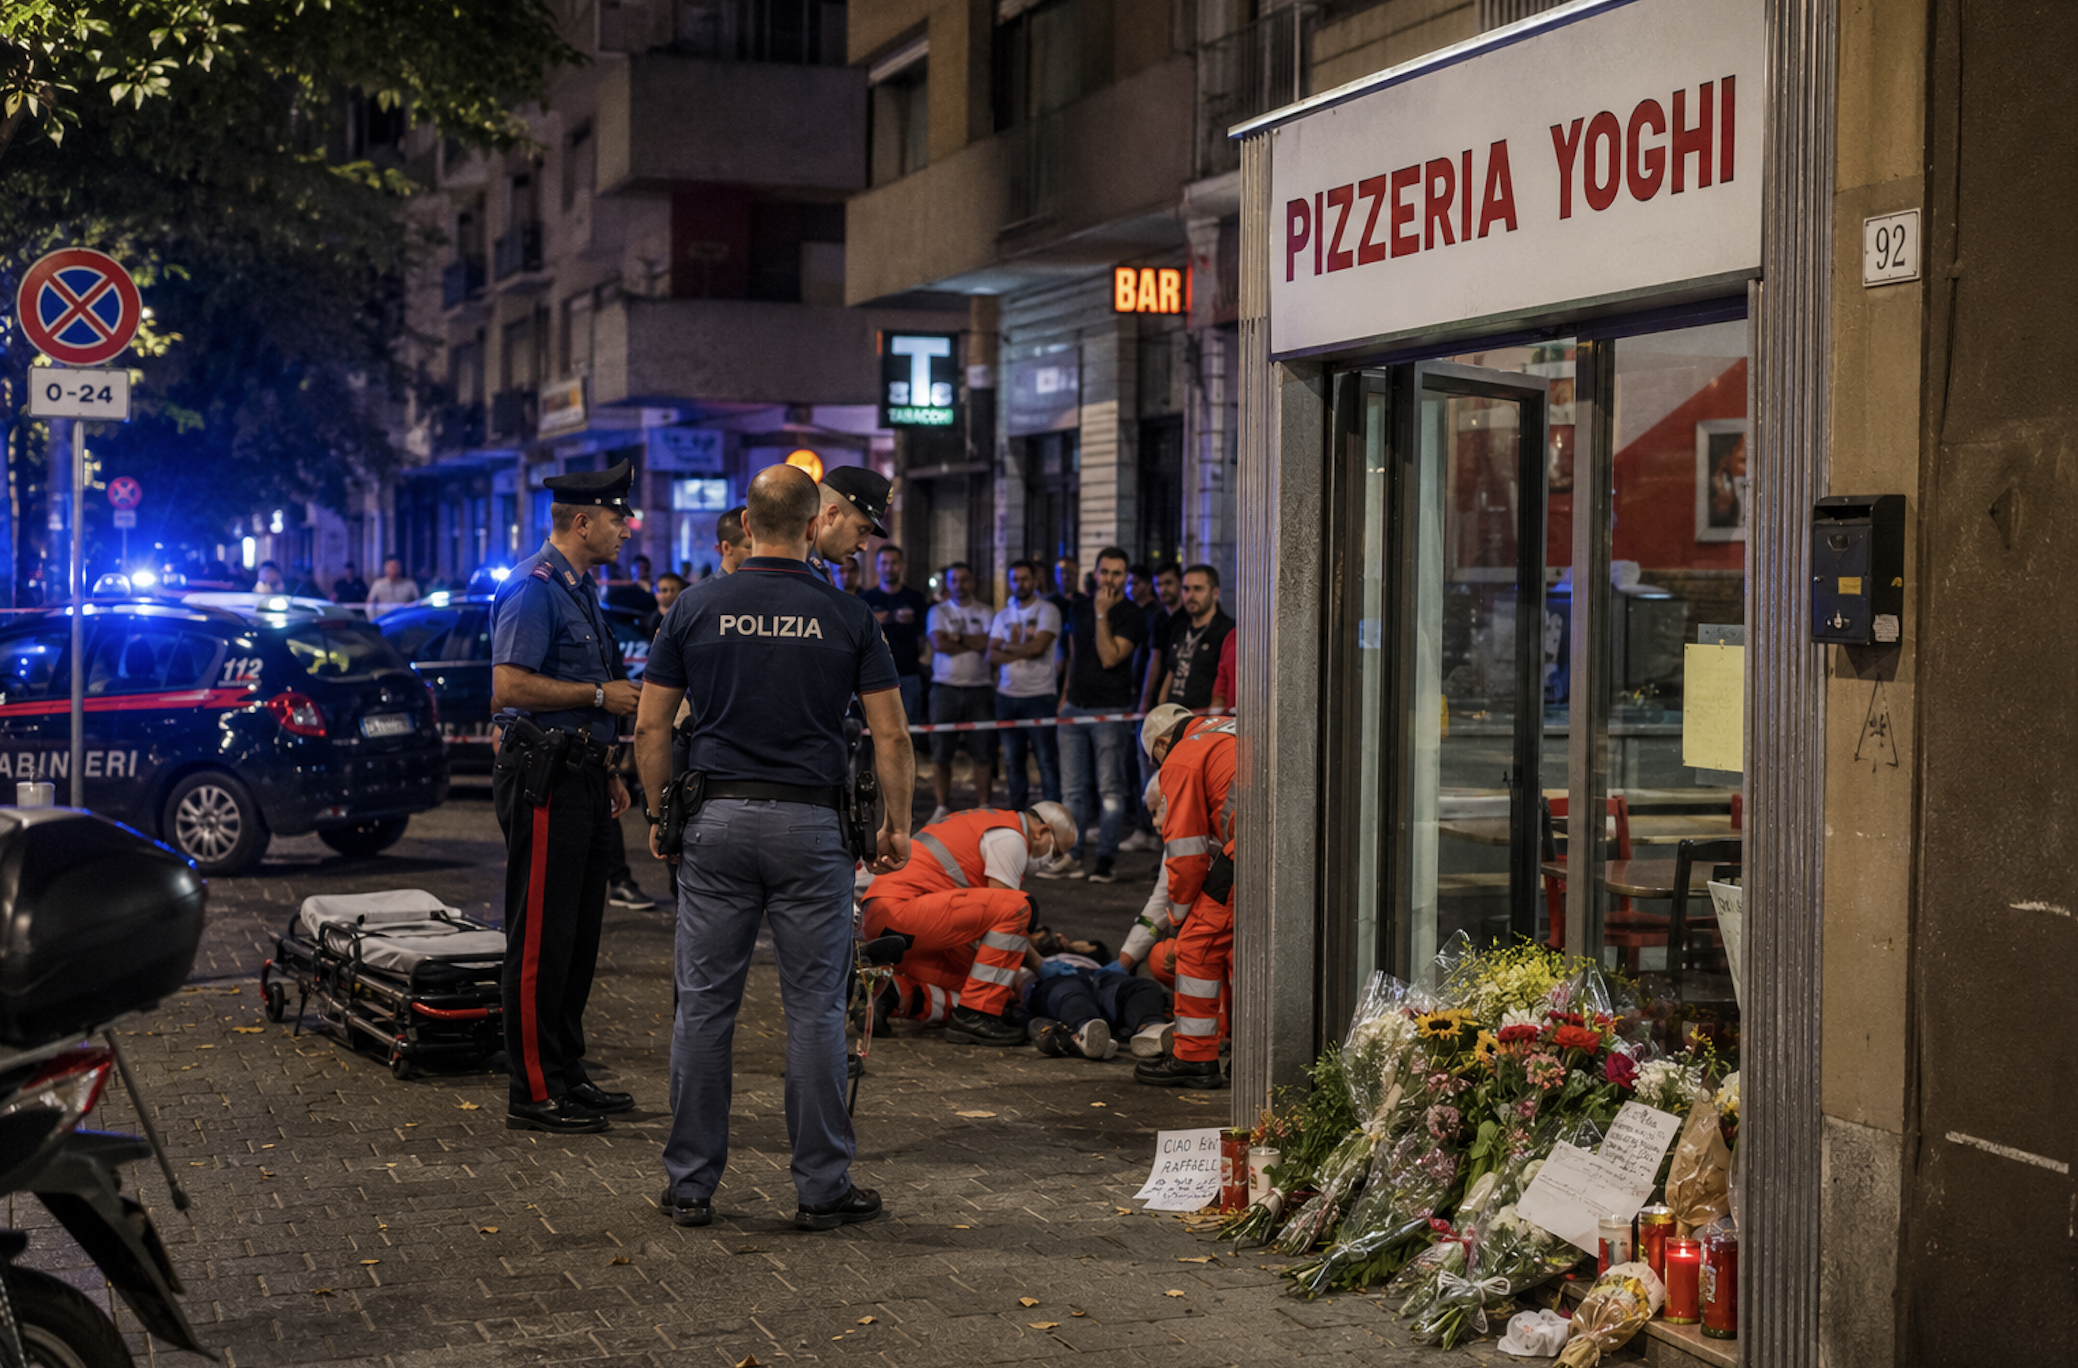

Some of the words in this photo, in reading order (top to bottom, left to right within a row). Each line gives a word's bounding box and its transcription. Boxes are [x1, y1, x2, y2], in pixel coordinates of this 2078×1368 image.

[1285, 138, 1518, 283] PIZZERIA
[1550, 74, 1737, 221] YOGHI
[1876, 224, 1906, 270] 92
[1115, 266, 1181, 314] BAR
[891, 335, 951, 407] T
[46, 383, 113, 404] 0-24
[719, 614, 824, 640] POLIZIA
[223, 657, 264, 681] 112
[0, 750, 138, 778] ABINERI
[1163, 1138, 1192, 1154] CIAO
